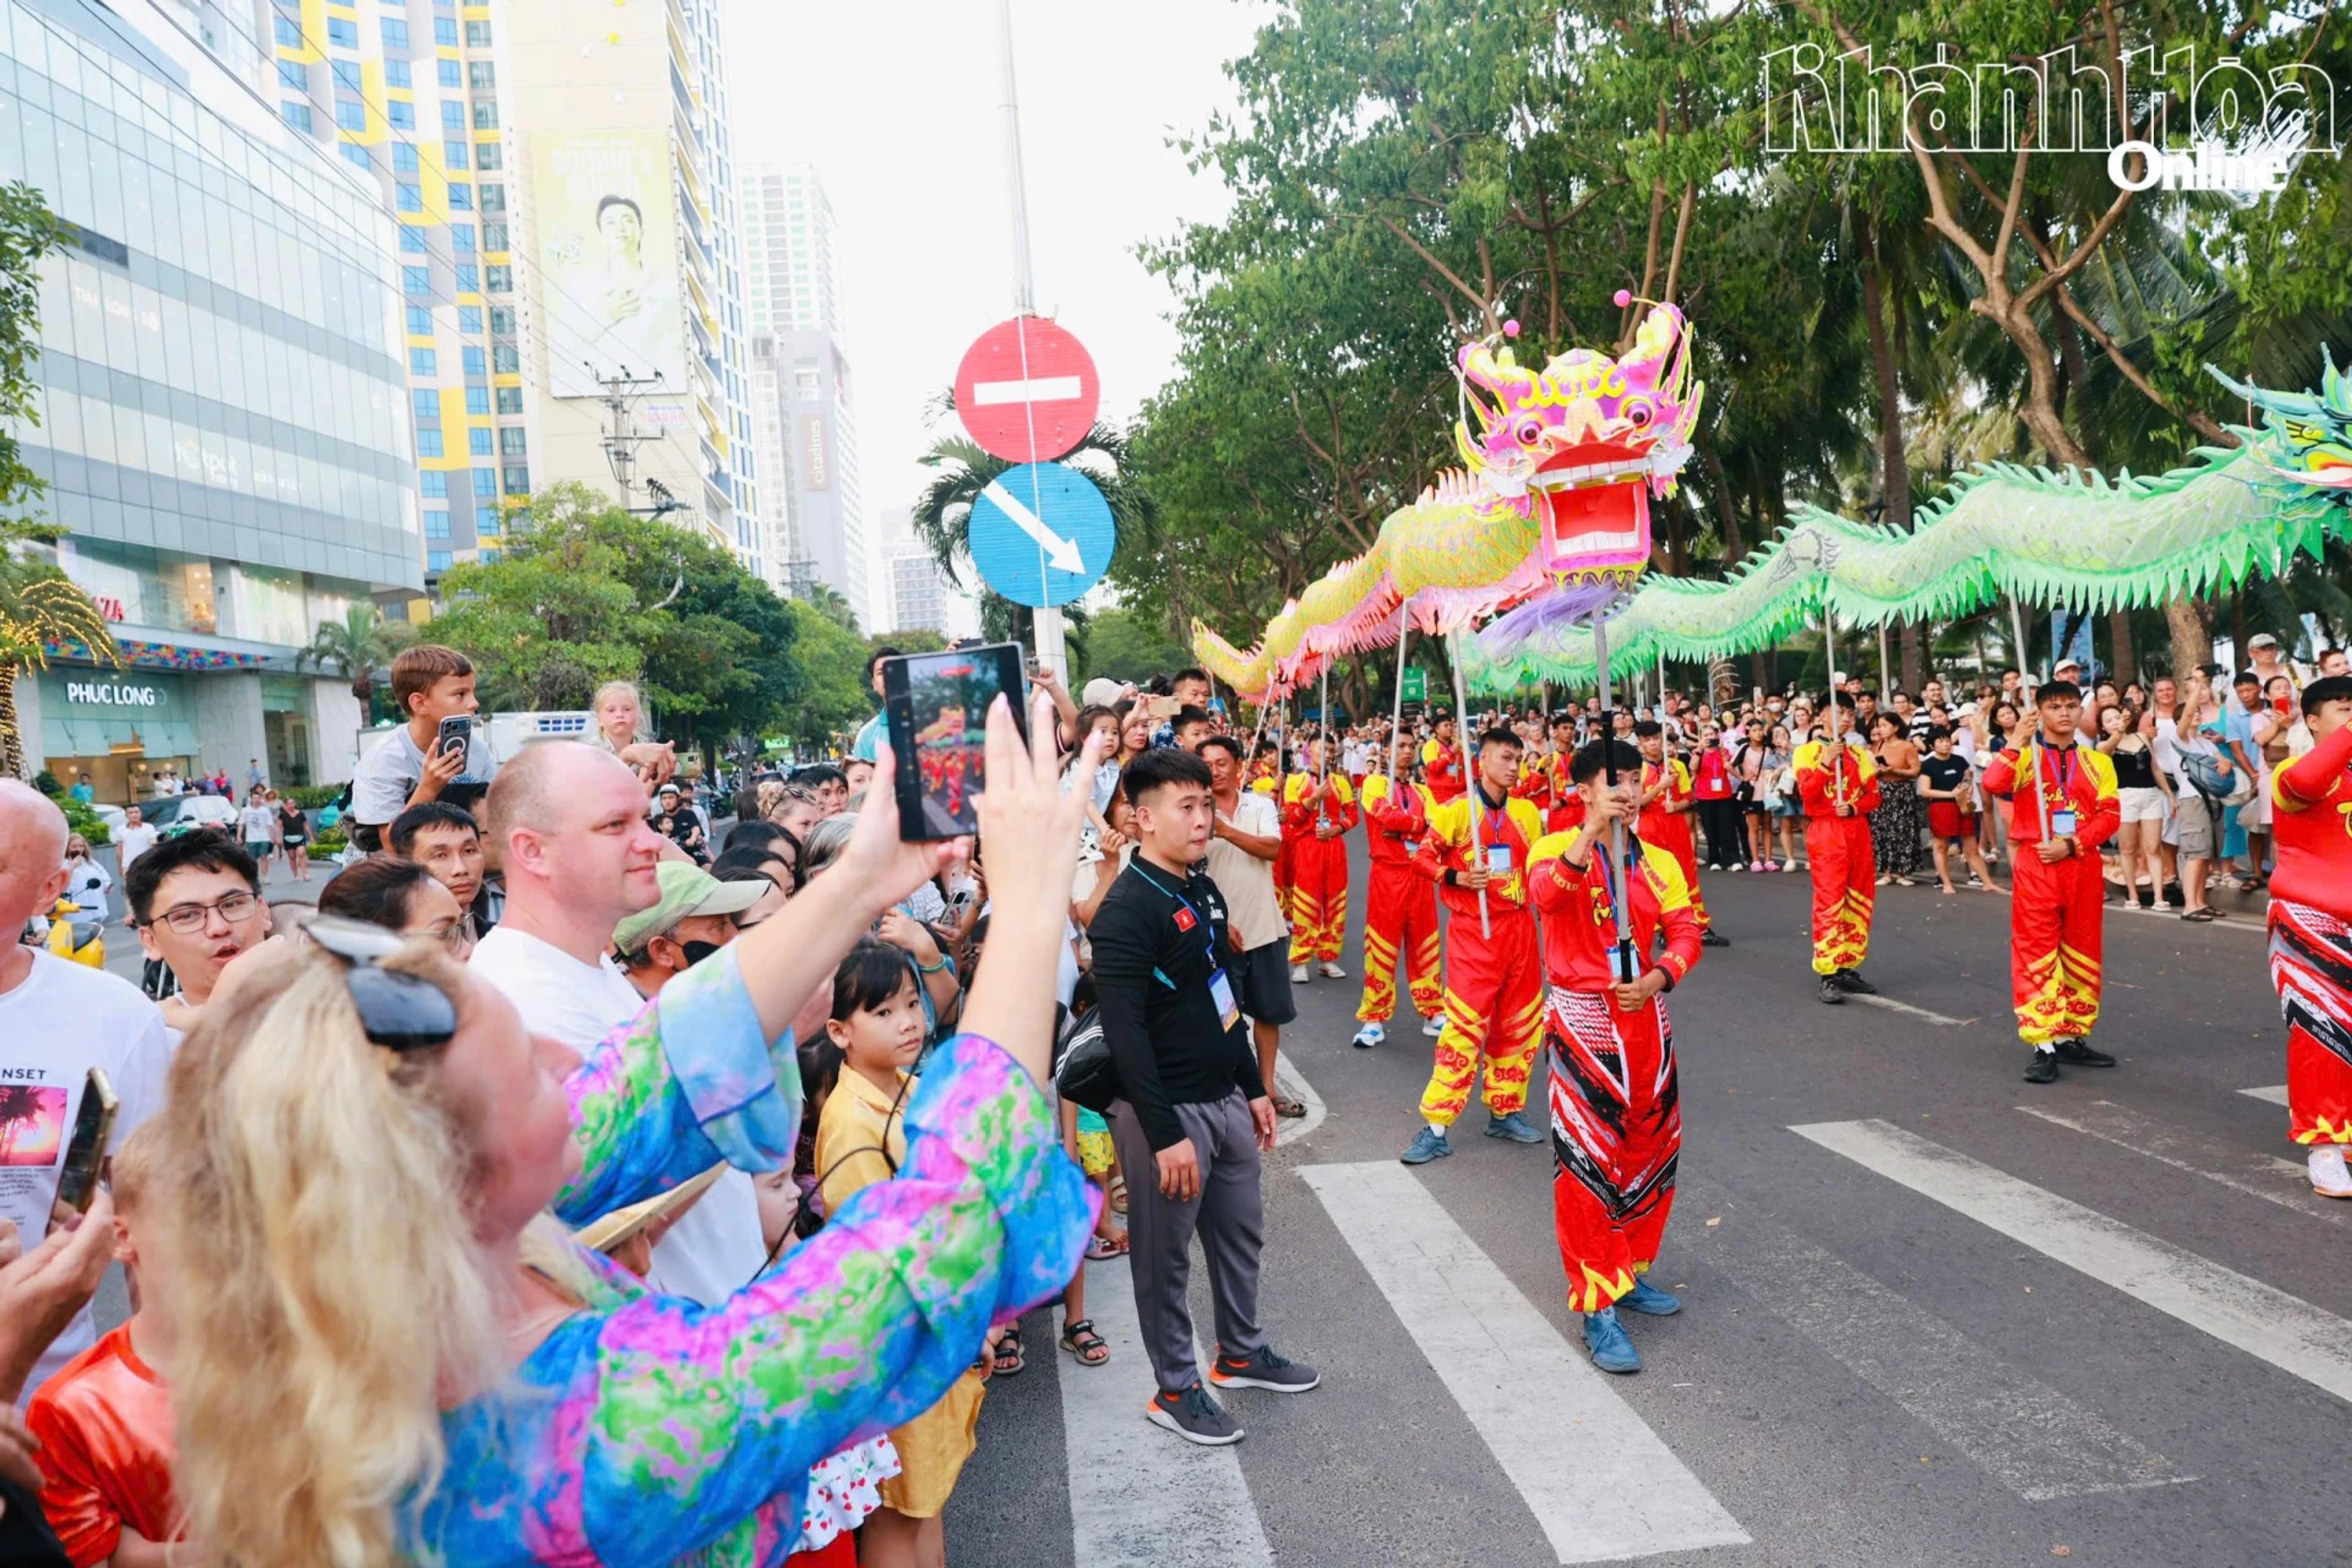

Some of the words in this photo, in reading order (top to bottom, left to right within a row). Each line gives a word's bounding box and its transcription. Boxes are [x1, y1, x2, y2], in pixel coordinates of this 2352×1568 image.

[809, 420, 824, 484] citadines
[67, 682, 112, 704] PHUC
[113, 685, 156, 706] LONG
